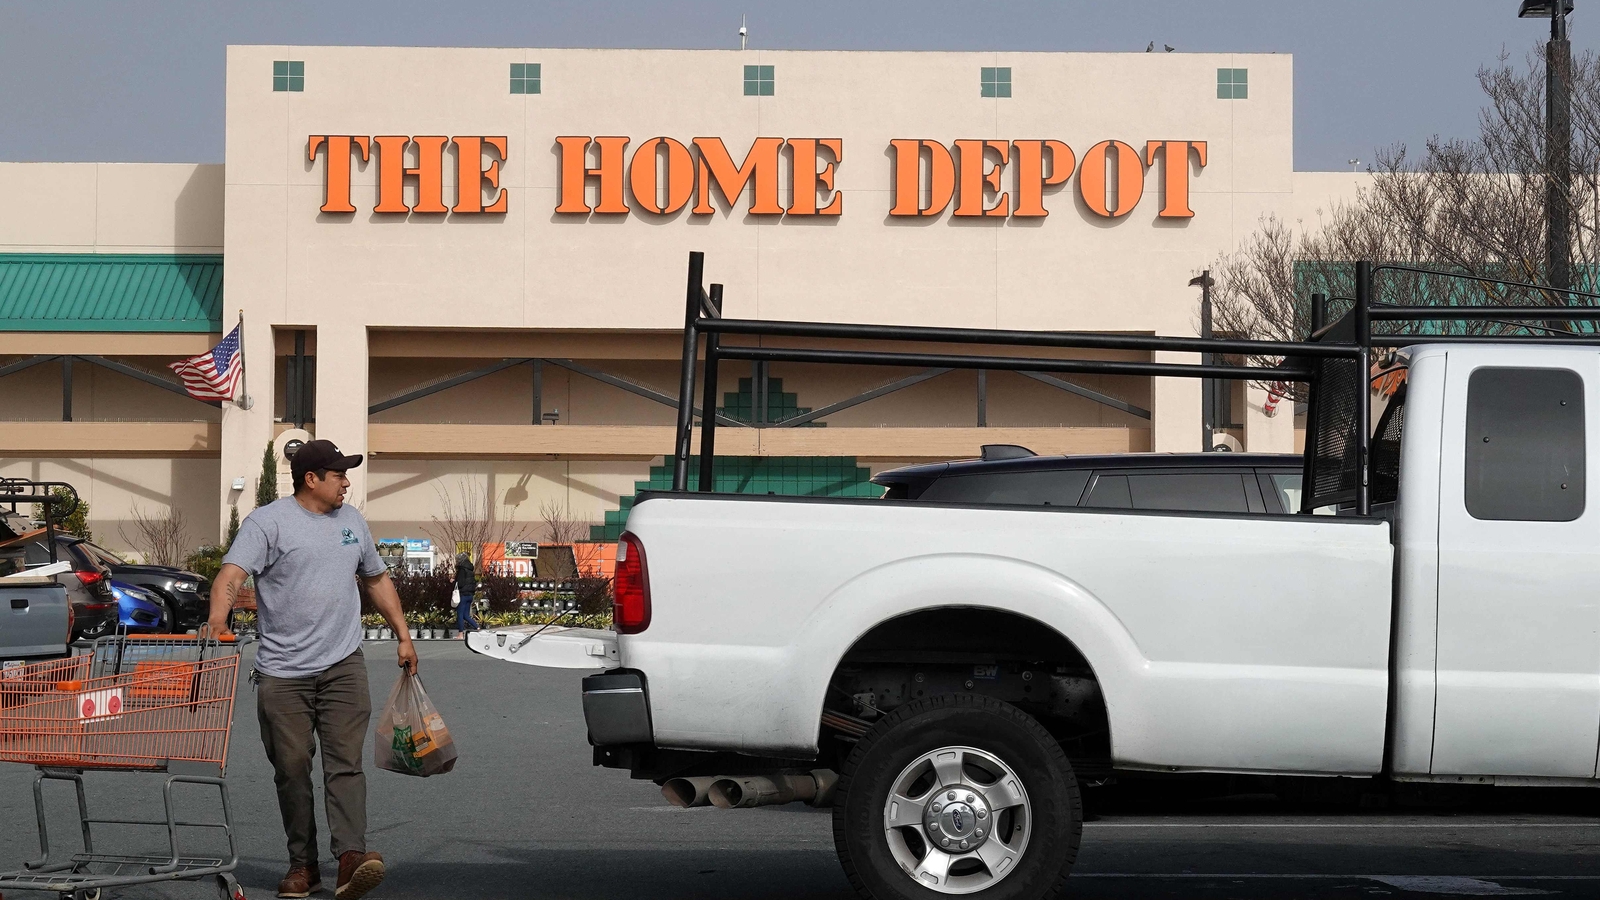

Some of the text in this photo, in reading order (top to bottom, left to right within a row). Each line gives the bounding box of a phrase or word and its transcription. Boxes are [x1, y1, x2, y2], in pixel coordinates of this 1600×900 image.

[308, 135, 1208, 218] THE HOME DEPOT
